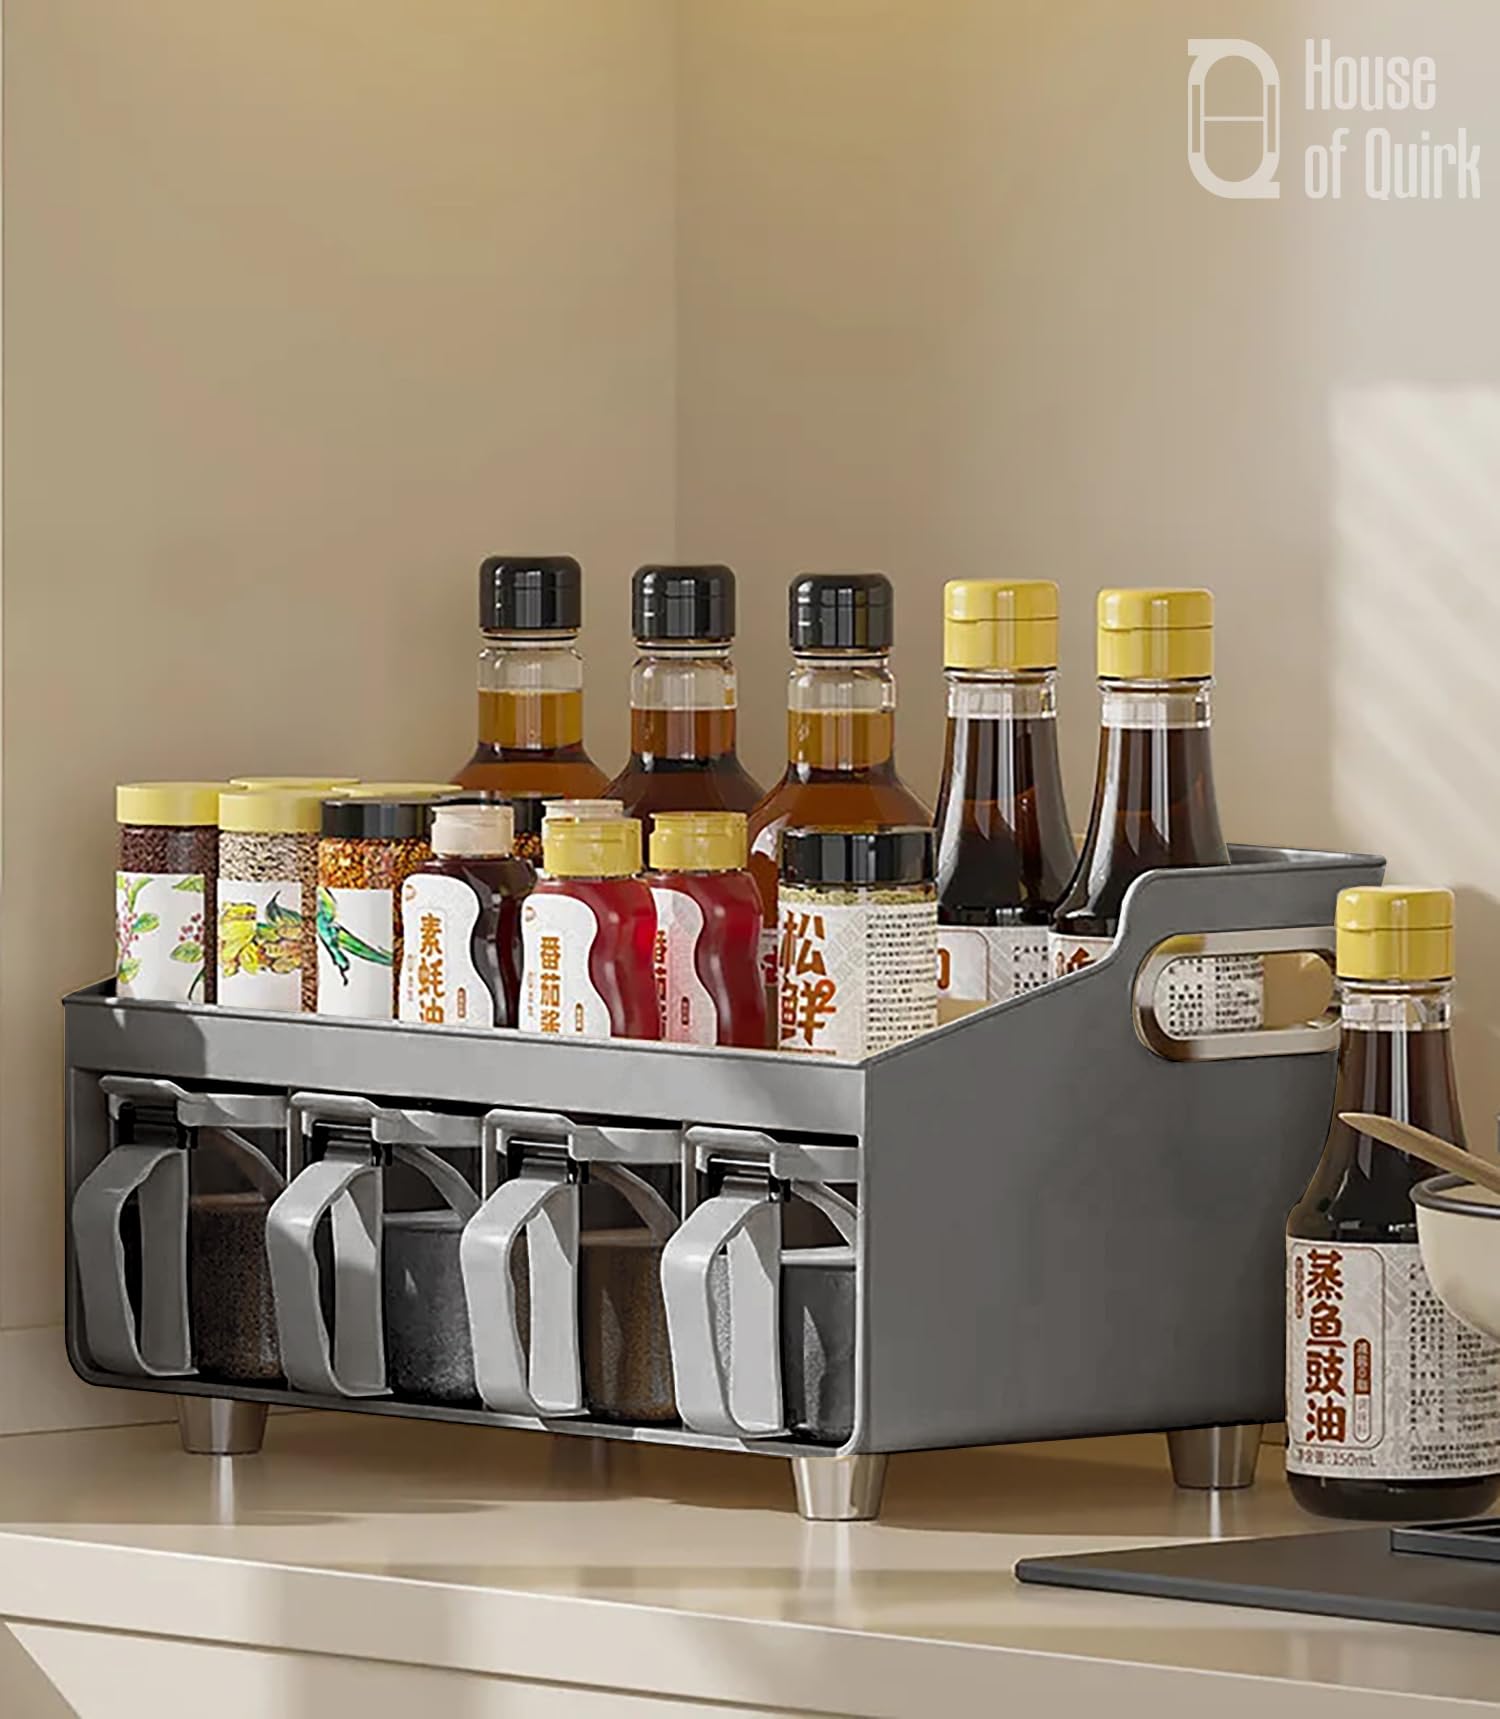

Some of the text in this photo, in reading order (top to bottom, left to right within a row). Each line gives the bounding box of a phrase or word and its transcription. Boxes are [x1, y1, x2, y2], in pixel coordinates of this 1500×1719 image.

[418, 912, 445, 1024] 素蚝油
[1304, 1248, 1347, 1443] 蒸鱼豉油
